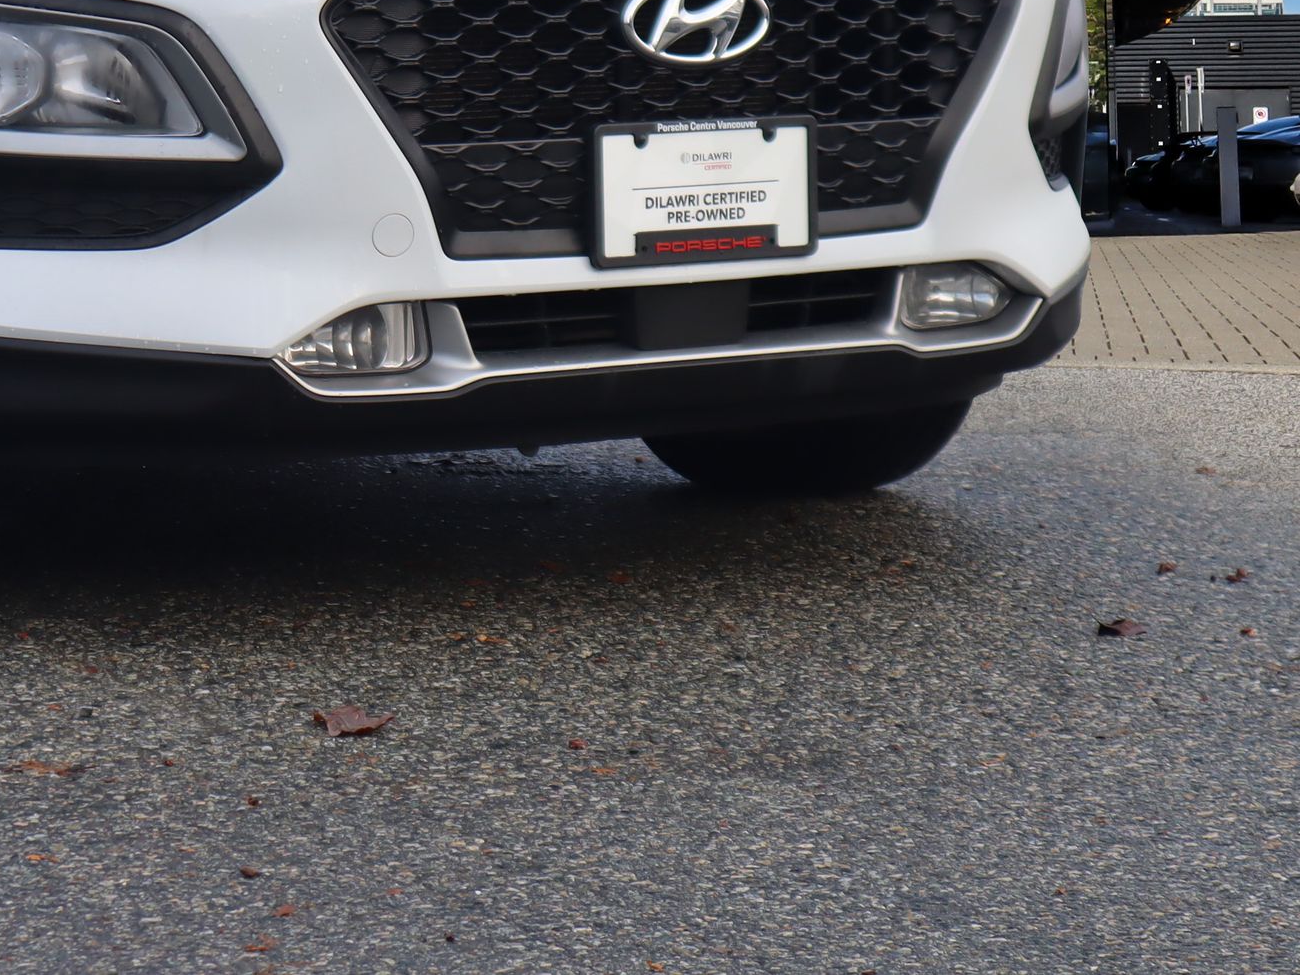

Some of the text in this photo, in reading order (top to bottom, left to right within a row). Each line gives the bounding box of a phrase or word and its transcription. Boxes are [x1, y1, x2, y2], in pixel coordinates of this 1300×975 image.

[657, 120, 758, 133] Porsche Centre Vancouver
[692, 152, 732, 163] DILAWRI
[704, 163, 732, 171] CERTIFIED
[645, 190, 767, 210] DILAWRI CERTIFIED
[667, 207, 746, 224] PRE-OWNED
[655, 236, 764, 255] PORSCHE
